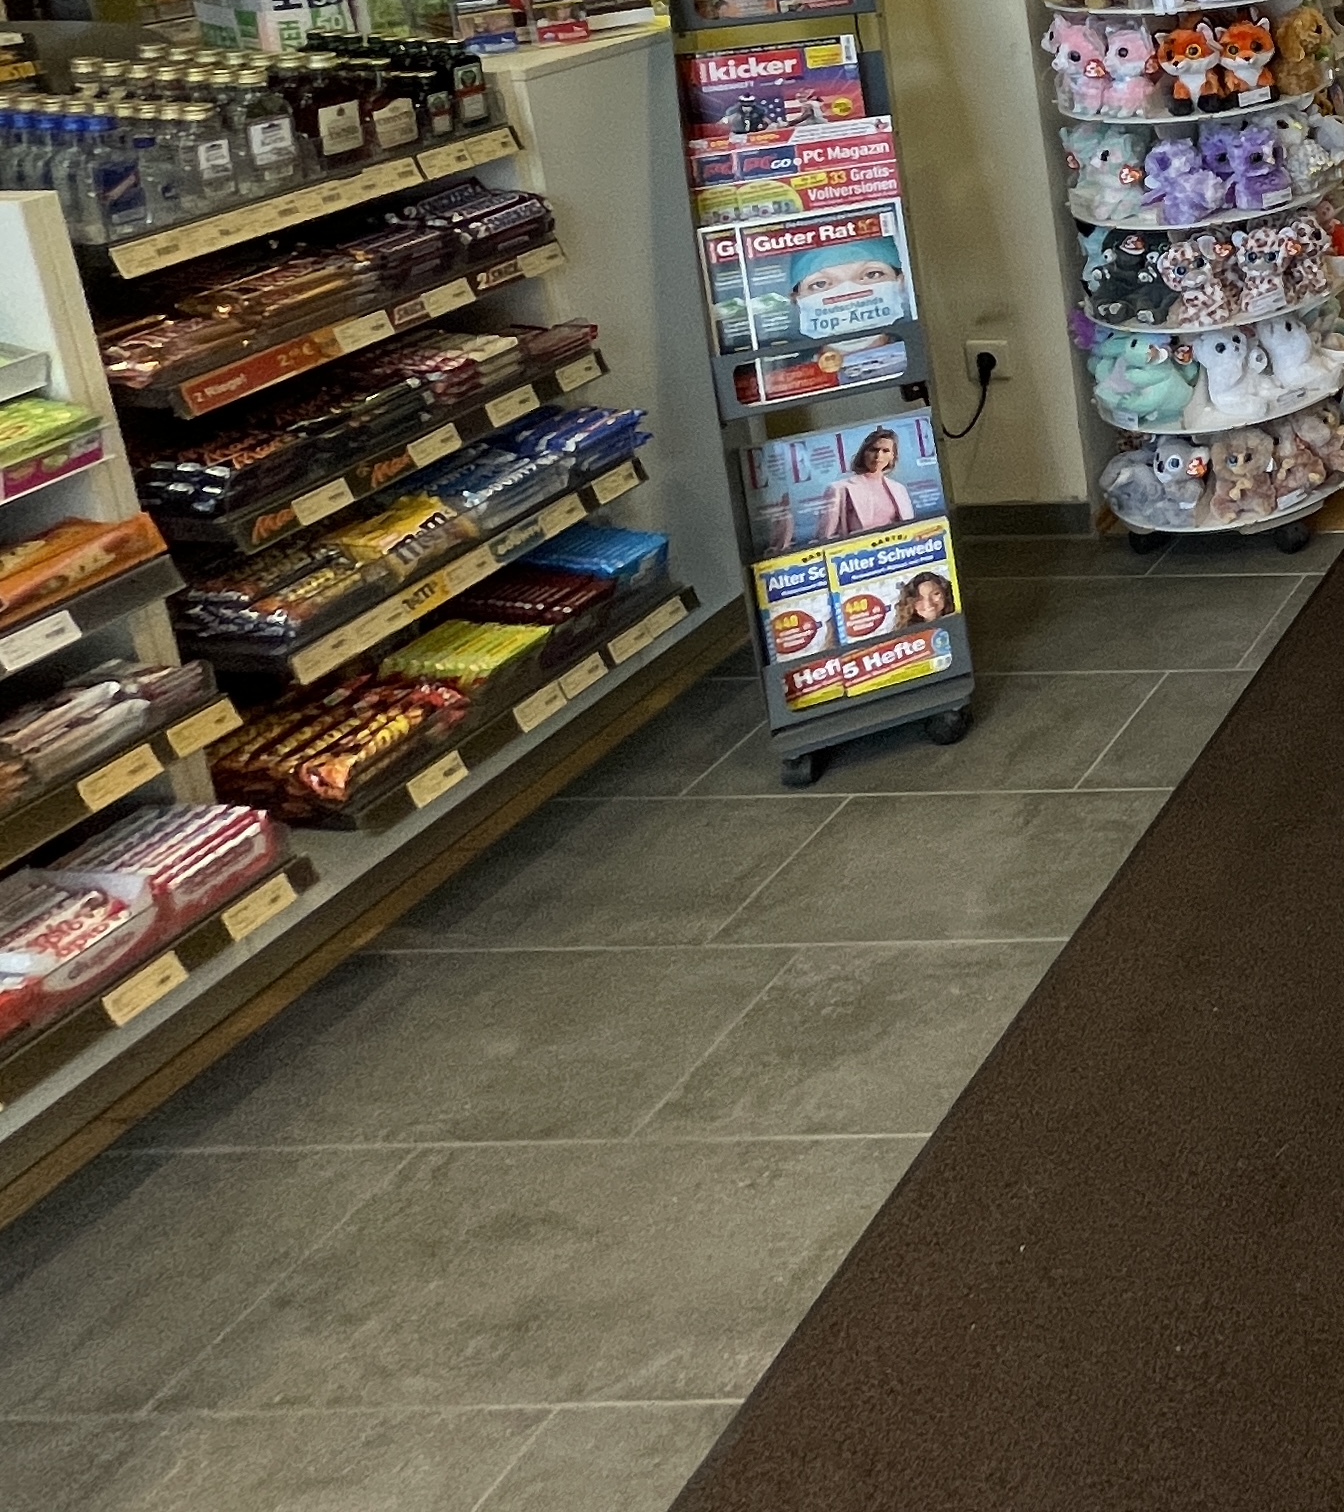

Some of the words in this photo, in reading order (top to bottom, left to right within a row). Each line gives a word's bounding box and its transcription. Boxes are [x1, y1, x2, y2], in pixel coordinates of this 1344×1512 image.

[708, 55, 798, 82] kicker
[802, 148, 824, 164] PC
[826, 141, 890, 162] Magazin
[850, 167, 895, 184] Gratis-
[807, 178, 898, 203] Vollversionen
[753, 226, 816, 254] Guter
[819, 223, 856, 242] Rat
[839, 552, 876, 576] Alter
[877, 538, 943, 565] Schwede
[768, 572, 806, 592] Alter
[842, 662, 862, 679] 5
[864, 637, 927, 673] Hefte
